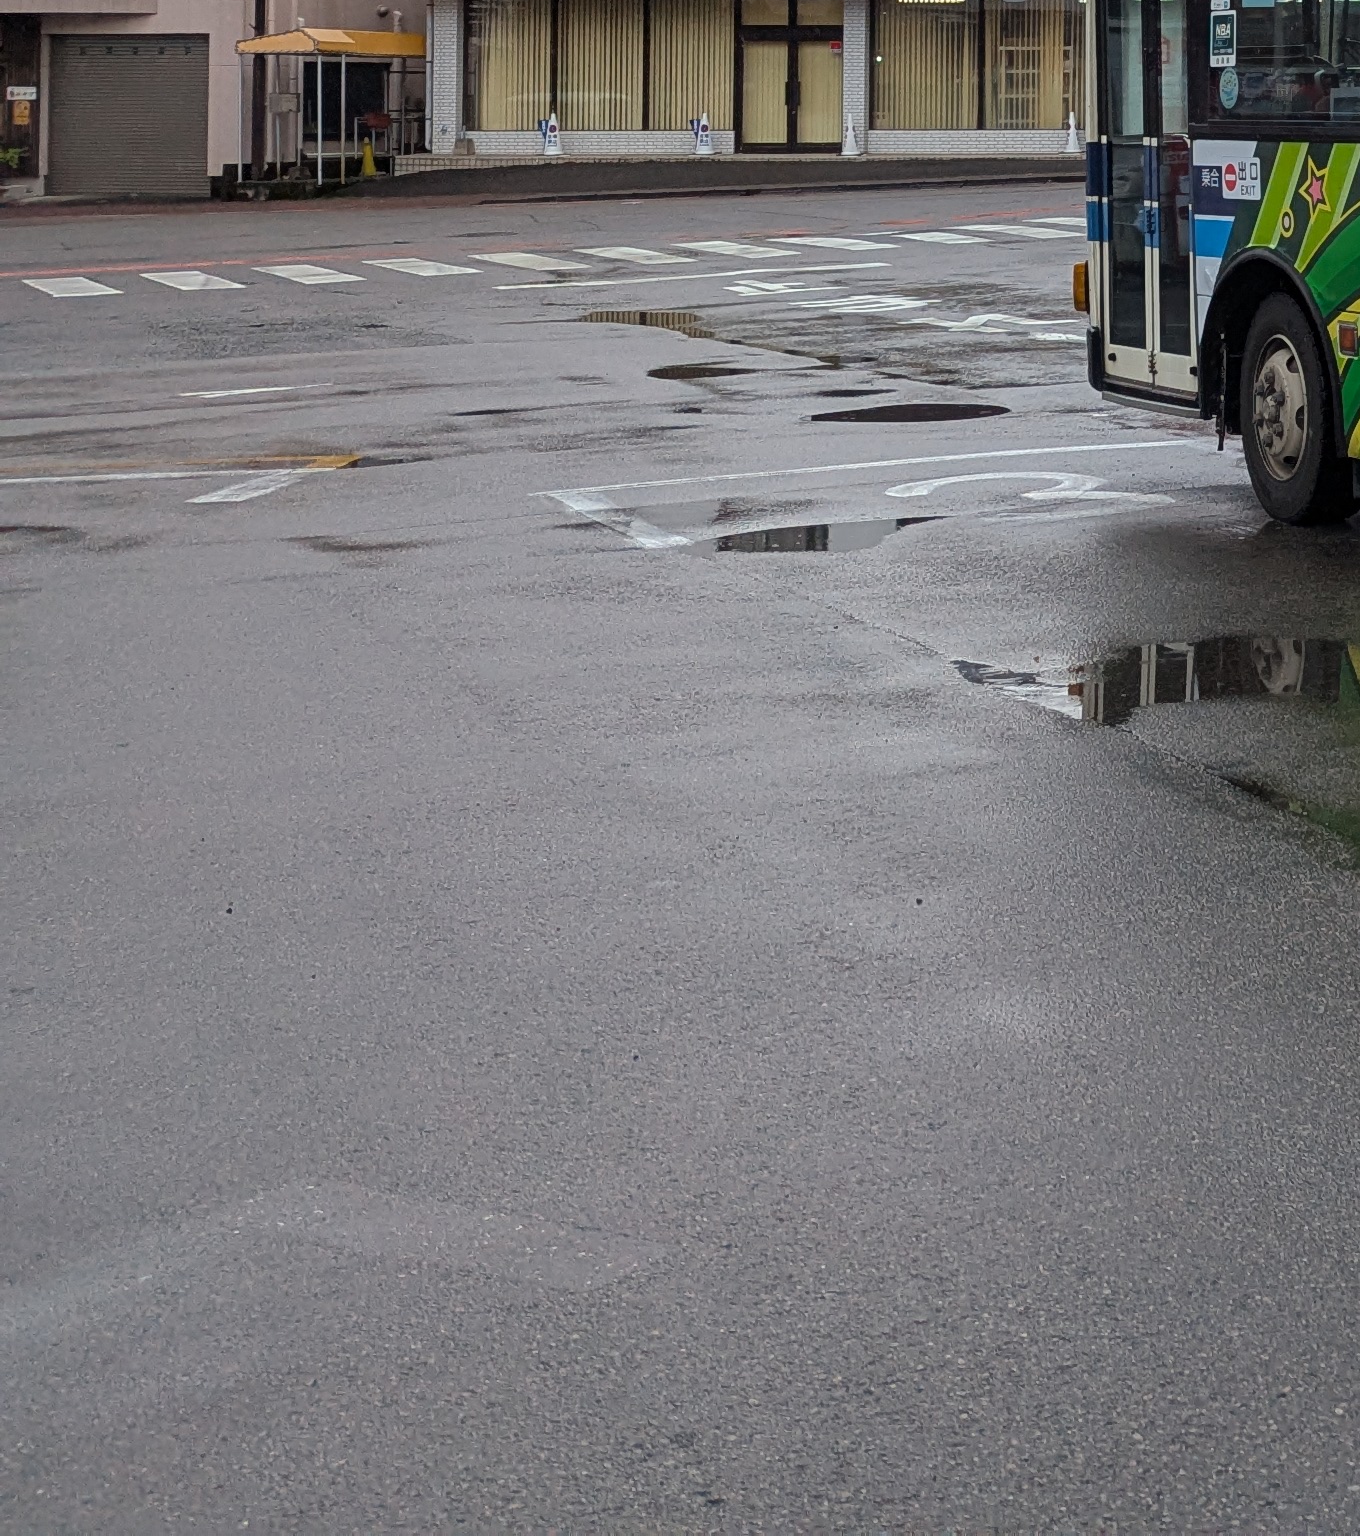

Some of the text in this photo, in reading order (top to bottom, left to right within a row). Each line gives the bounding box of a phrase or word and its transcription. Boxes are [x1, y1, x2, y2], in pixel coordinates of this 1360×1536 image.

[1201, 168, 1220, 187] 乗合
[1238, 161, 1258, 181] 出口
[1241, 185, 1256, 196] EXIT
